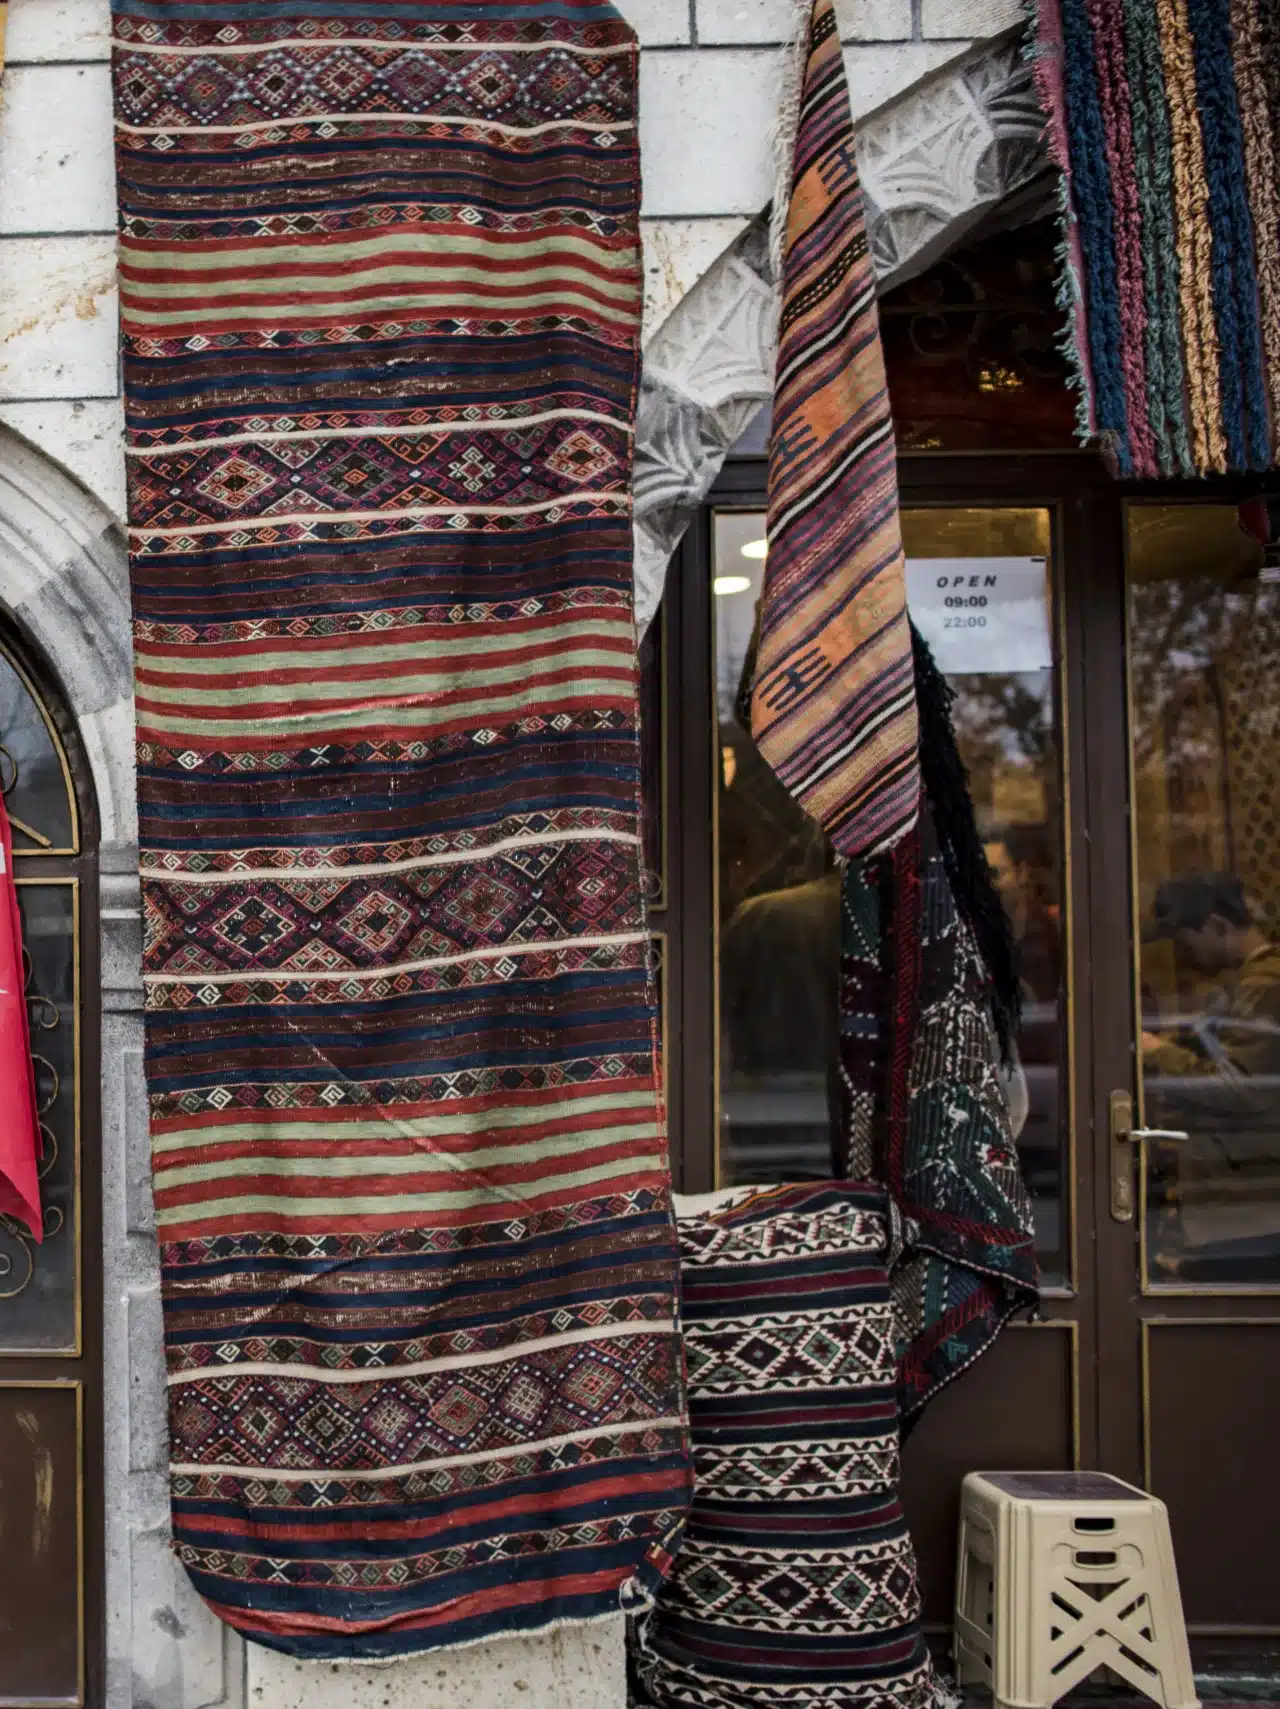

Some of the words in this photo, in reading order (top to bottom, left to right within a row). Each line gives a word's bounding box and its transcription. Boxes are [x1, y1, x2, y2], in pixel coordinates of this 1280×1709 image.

[936, 575, 997, 588] OPEN
[944, 595, 988, 608] 09:00
[943, 616, 987, 628] 22:00
